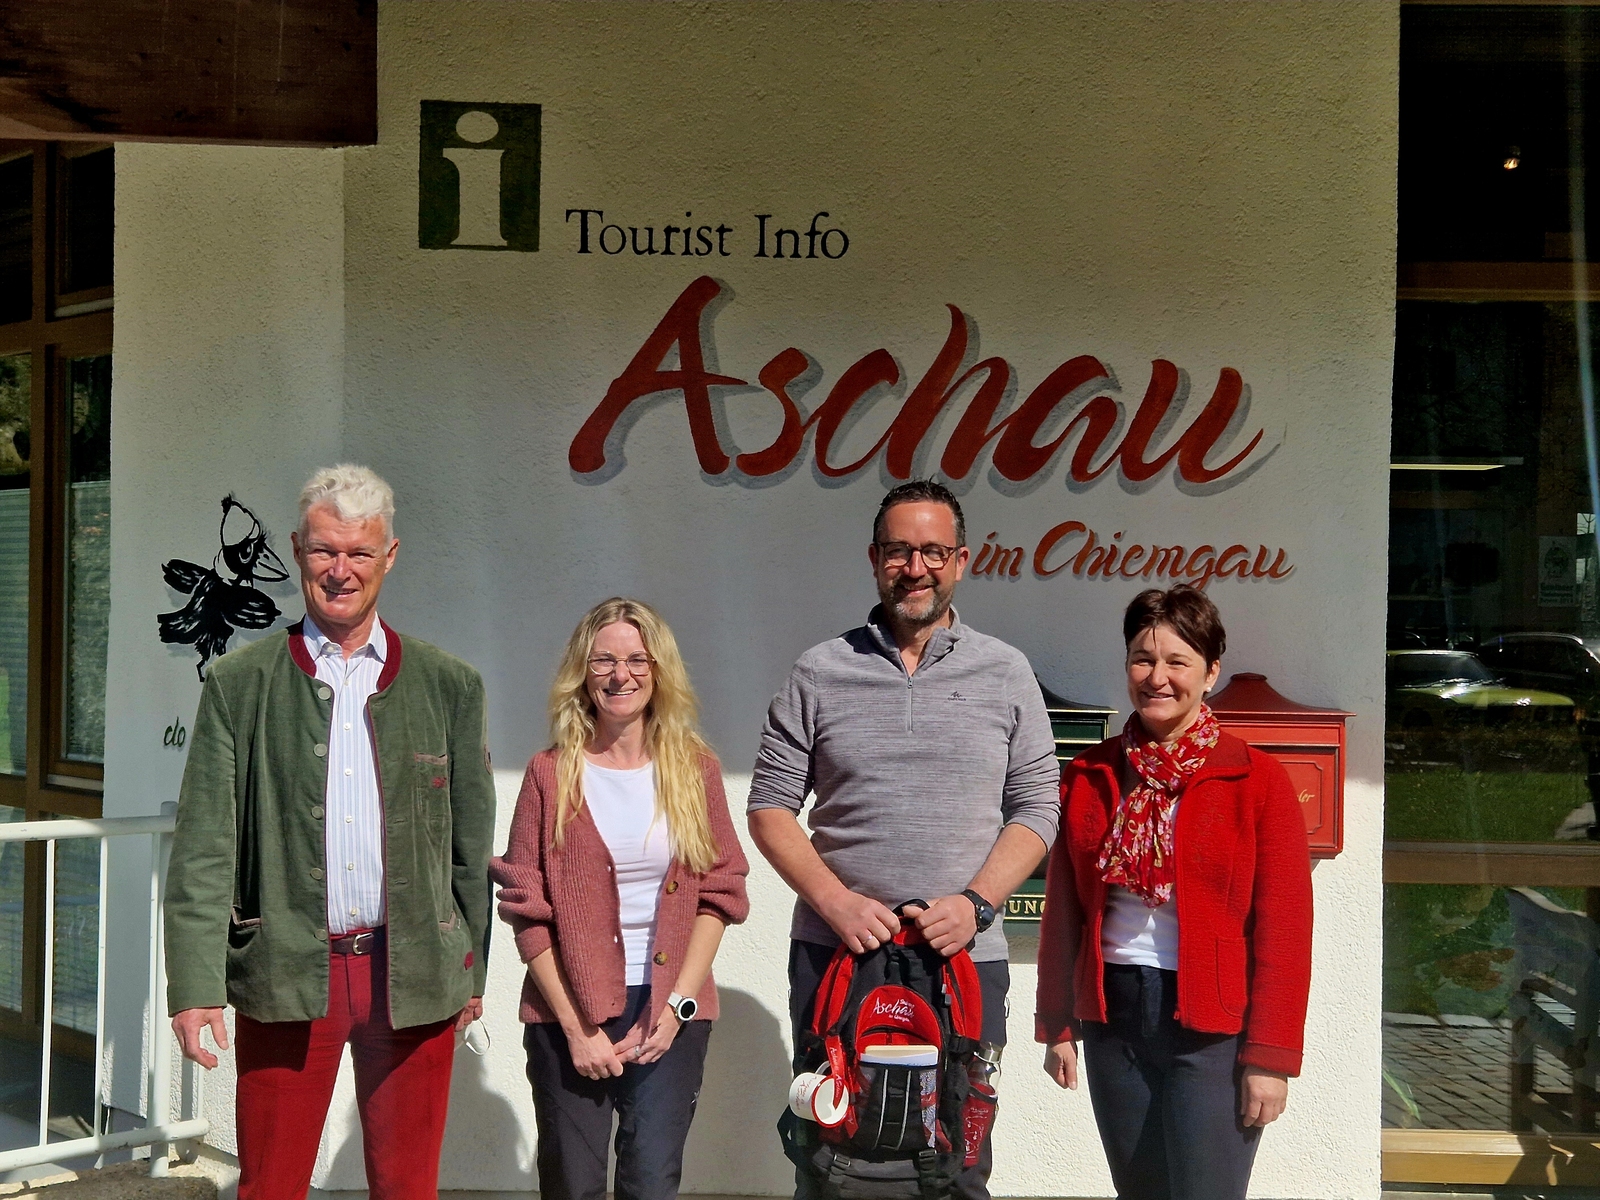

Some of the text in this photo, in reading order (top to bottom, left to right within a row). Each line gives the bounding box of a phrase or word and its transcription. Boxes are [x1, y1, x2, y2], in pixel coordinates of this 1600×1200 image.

[566, 209, 850, 259] Tourist Info
[568, 275, 1266, 486] Aschau
[971, 521, 1292, 587] im Chiemgau
